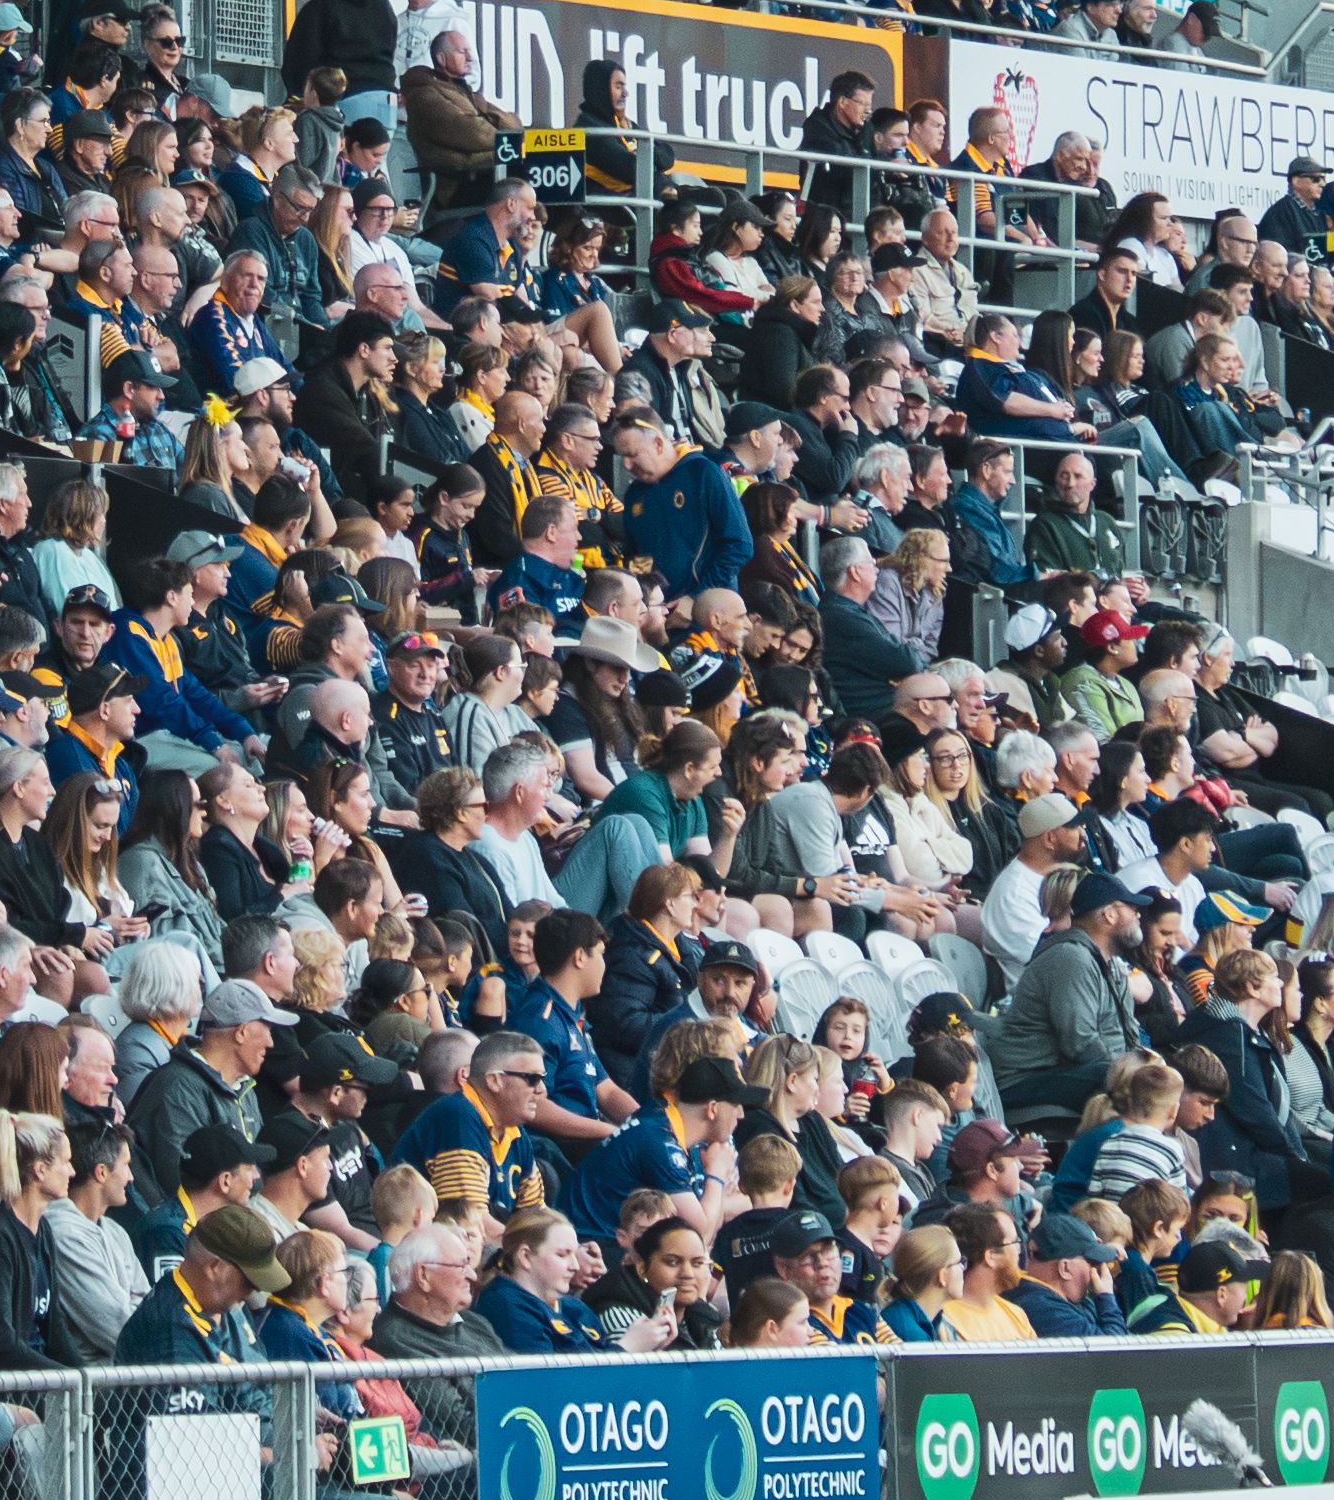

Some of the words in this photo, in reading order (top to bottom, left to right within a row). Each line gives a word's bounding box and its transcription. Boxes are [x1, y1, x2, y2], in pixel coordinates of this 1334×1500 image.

[533, 133, 576, 148] AISLE
[528, 166, 570, 189] 306
[1123, 171, 1163, 193] SOUND
[1176, 177, 1215, 201] VISION
[560, 1400, 669, 1454] OTAGO
[761, 1392, 866, 1445] OTAGO
[1093, 1415, 1142, 1472] GO
[1280, 1408, 1325, 1462] GO
[922, 1422, 975, 1478] GO
[988, 1417, 1075, 1475] Media
[764, 1469, 866, 1500] POLYTECHNIC
